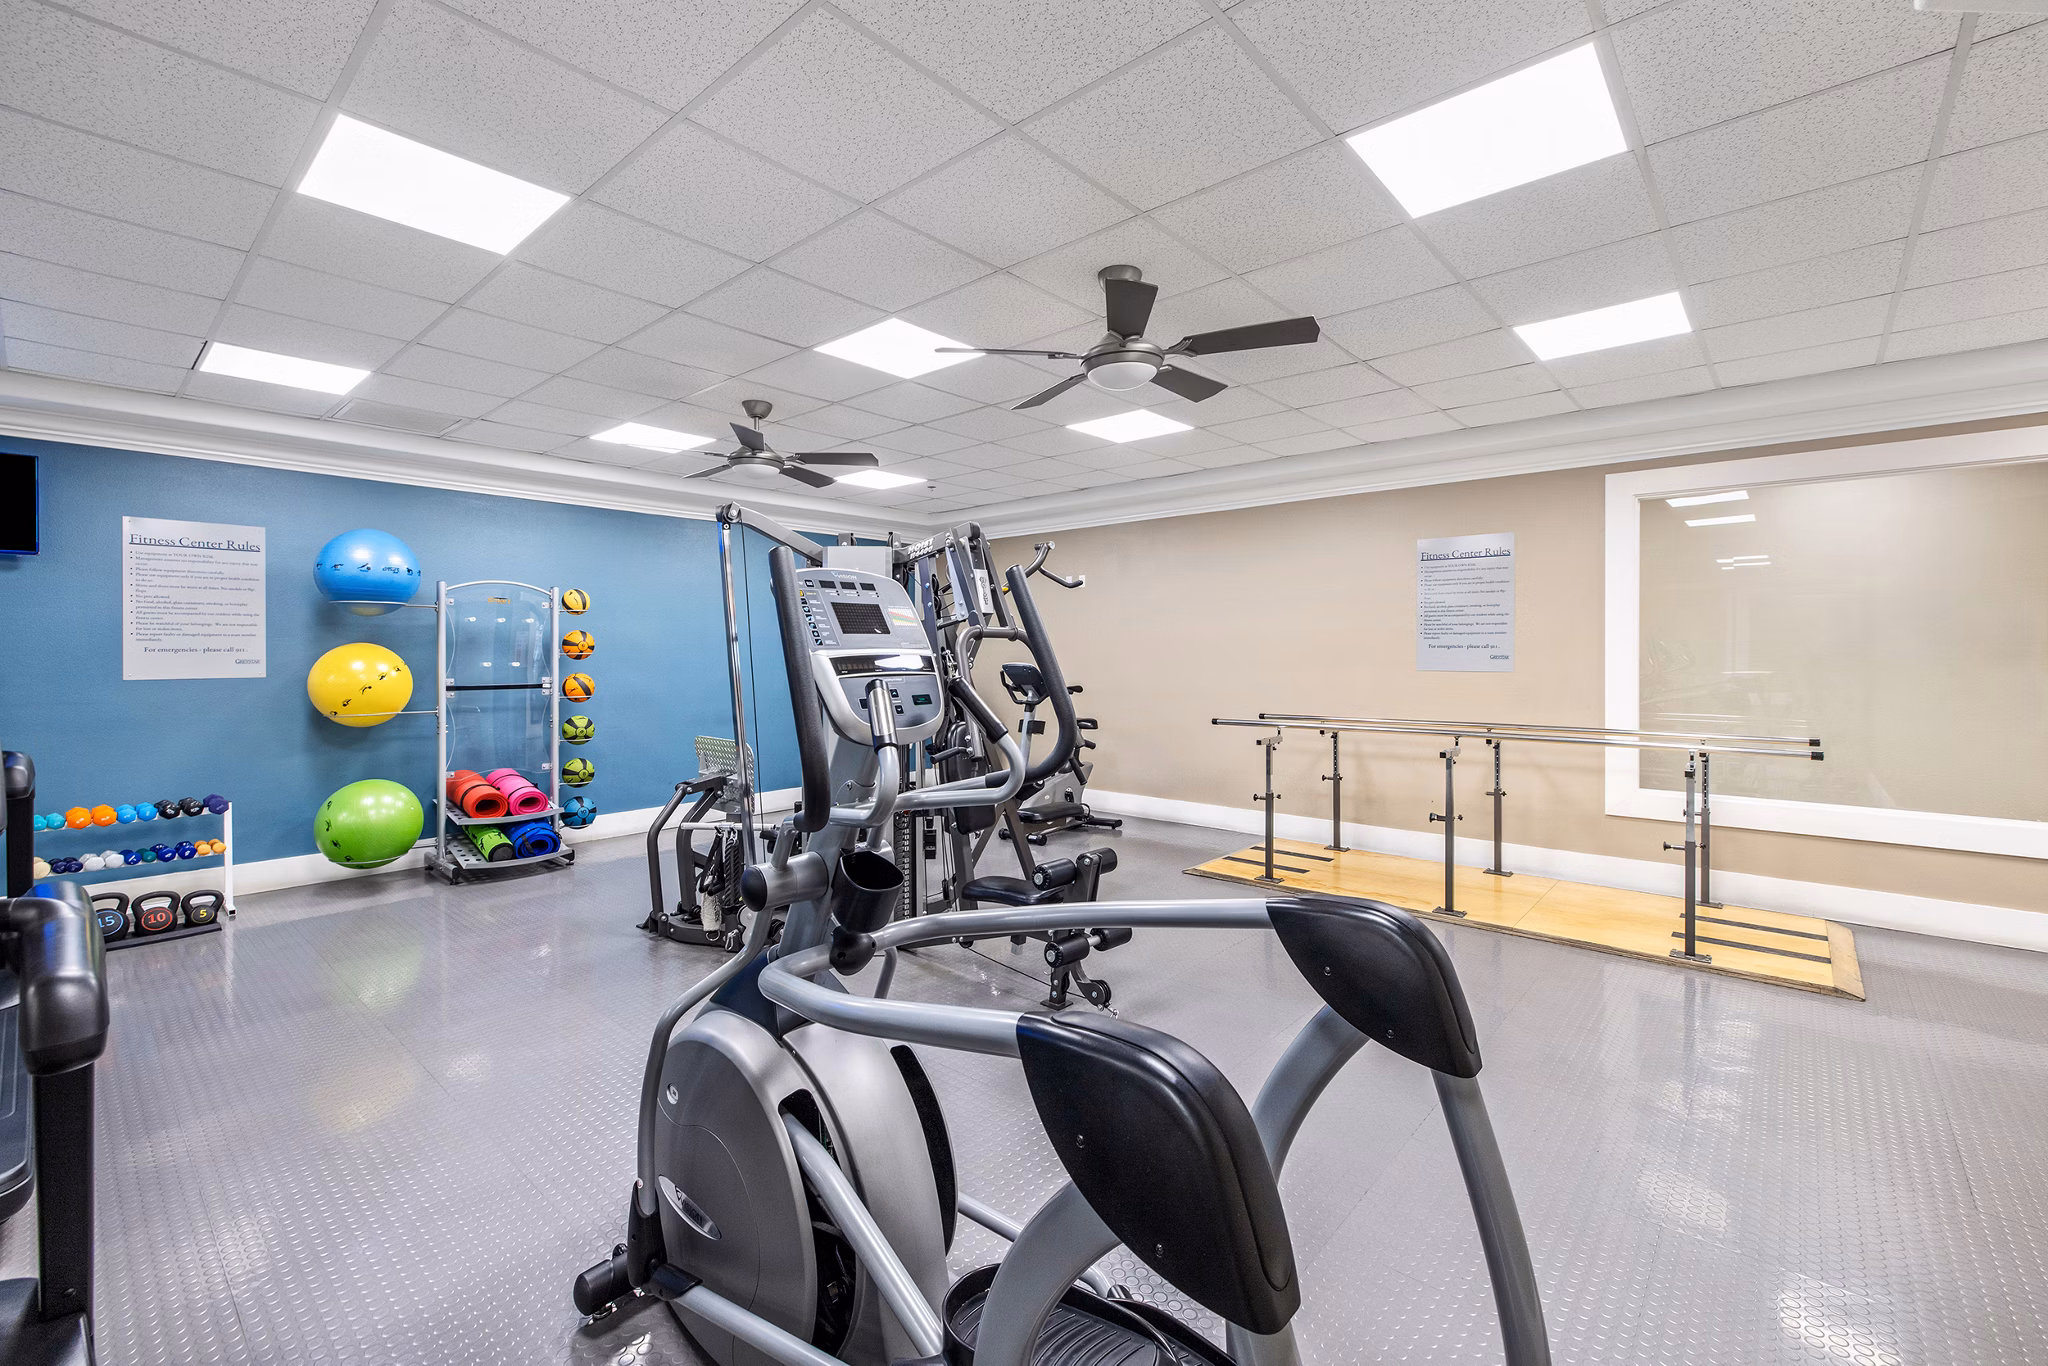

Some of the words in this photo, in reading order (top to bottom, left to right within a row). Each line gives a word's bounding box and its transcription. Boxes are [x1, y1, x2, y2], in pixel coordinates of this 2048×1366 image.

[129, 533, 176, 546] Fitness
[178, 536, 224, 549] Center
[226, 539, 261, 551] Rules
[1421, 551, 1450, 560] Fitness
[1451, 549, 1483, 559] Center
[1484, 546, 1511, 557] Rules
[202, 646, 222, 654] please
[148, 912, 166, 924] 10
[199, 909, 207, 918] 5
